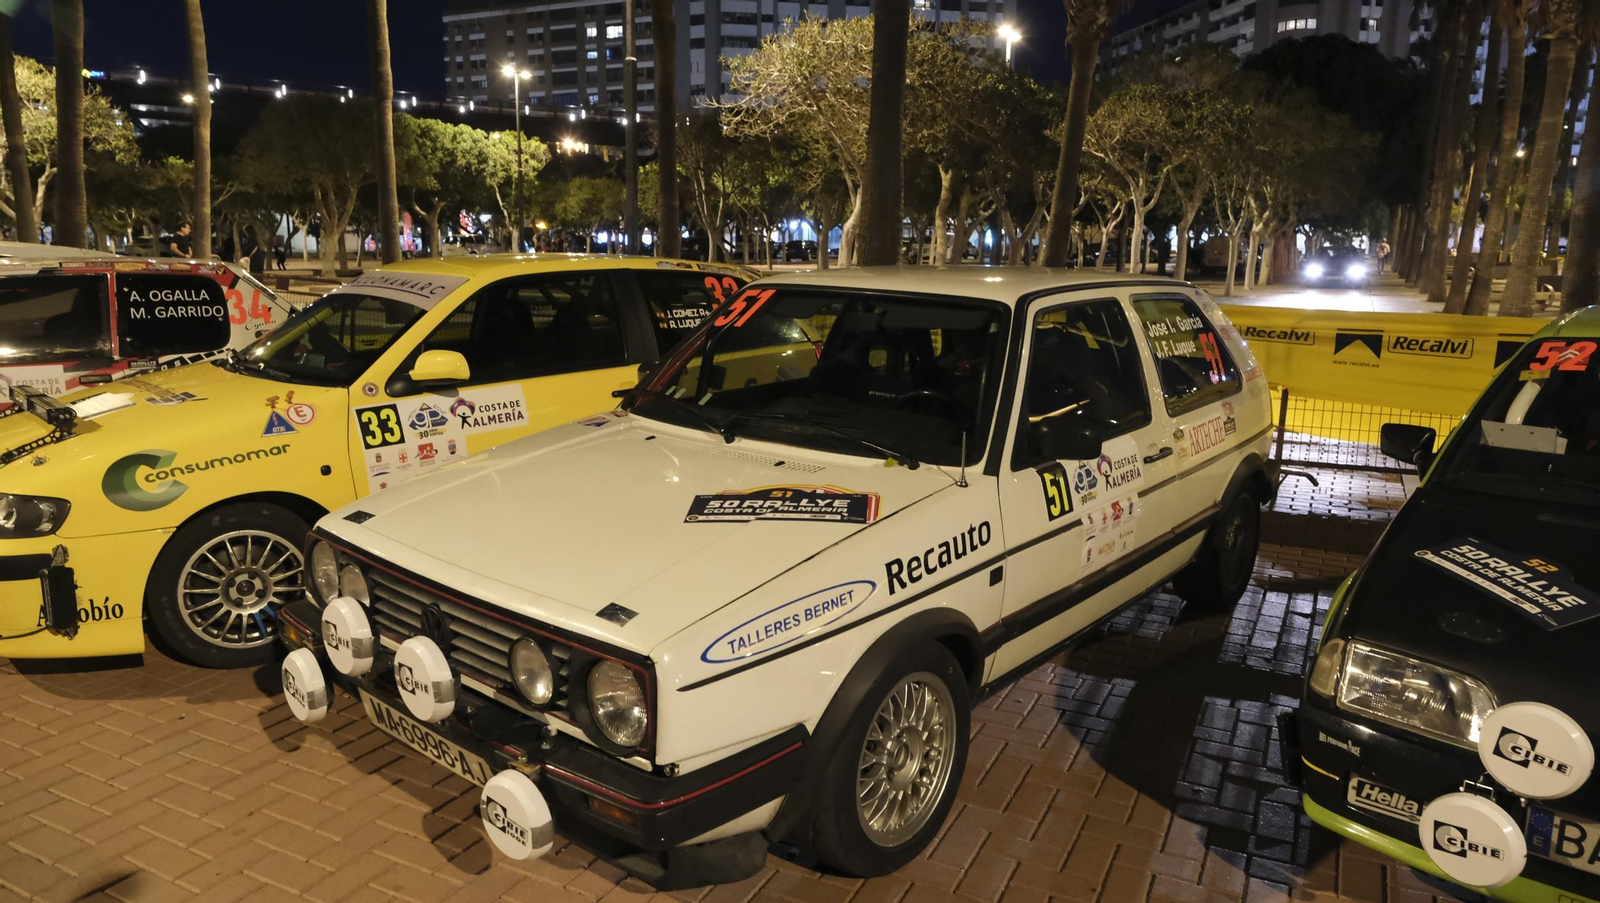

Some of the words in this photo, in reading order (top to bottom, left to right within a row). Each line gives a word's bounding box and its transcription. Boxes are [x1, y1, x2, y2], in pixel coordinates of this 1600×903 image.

[130, 290, 145, 302] A.
[150, 289, 210, 302] OGALLA
[130, 307, 151, 319] M.
[155, 305, 224, 318] GARRIDO
[225, 288, 272, 325] 34
[713, 289, 777, 328] 51
[1146, 320, 1169, 338] Jose
[1244, 326, 1311, 342] Recalvi
[1169, 339, 1197, 358] Luque
[1392, 336, 1470, 355] Recalvi
[1332, 359, 1380, 369] www.recalvi.es
[1529, 340, 1598, 372] 52
[478, 402, 509, 414] COSTA
[509, 399, 521, 409] DE
[361, 407, 402, 447] 33
[473, 408, 525, 428] ALMERÍA
[418, 430, 429, 440] 30
[1188, 416, 1226, 457] ARTECHE
[1113, 457, 1131, 471] COSTA
[1130, 454, 1138, 464] DE
[1112, 465, 1142, 489] ALMERÍA
[706, 499, 741, 508] 50
[741, 497, 851, 508] RALLYE
[769, 490, 795, 498] 51
[885, 520, 991, 596] Recauto
[1439, 549, 1483, 570] COSTA
[1478, 568, 1502, 579] DE
[1521, 558, 1560, 574] 52
[1451, 544, 1490, 560] 50
[1479, 557, 1588, 608] RALLYE
[36, 596, 124, 628] Aobío
[726, 614, 801, 655] TALLERES
[803, 589, 855, 622] BERNET
[330, 633, 350, 649] CIBIE
[405, 677, 429, 694] CIBIE
[1510, 745, 1569, 775] CIBIE
[1360, 783, 1419, 815] Hella
[493, 812, 527, 840] CIBIE
[1446, 836, 1502, 860] CIBIE
